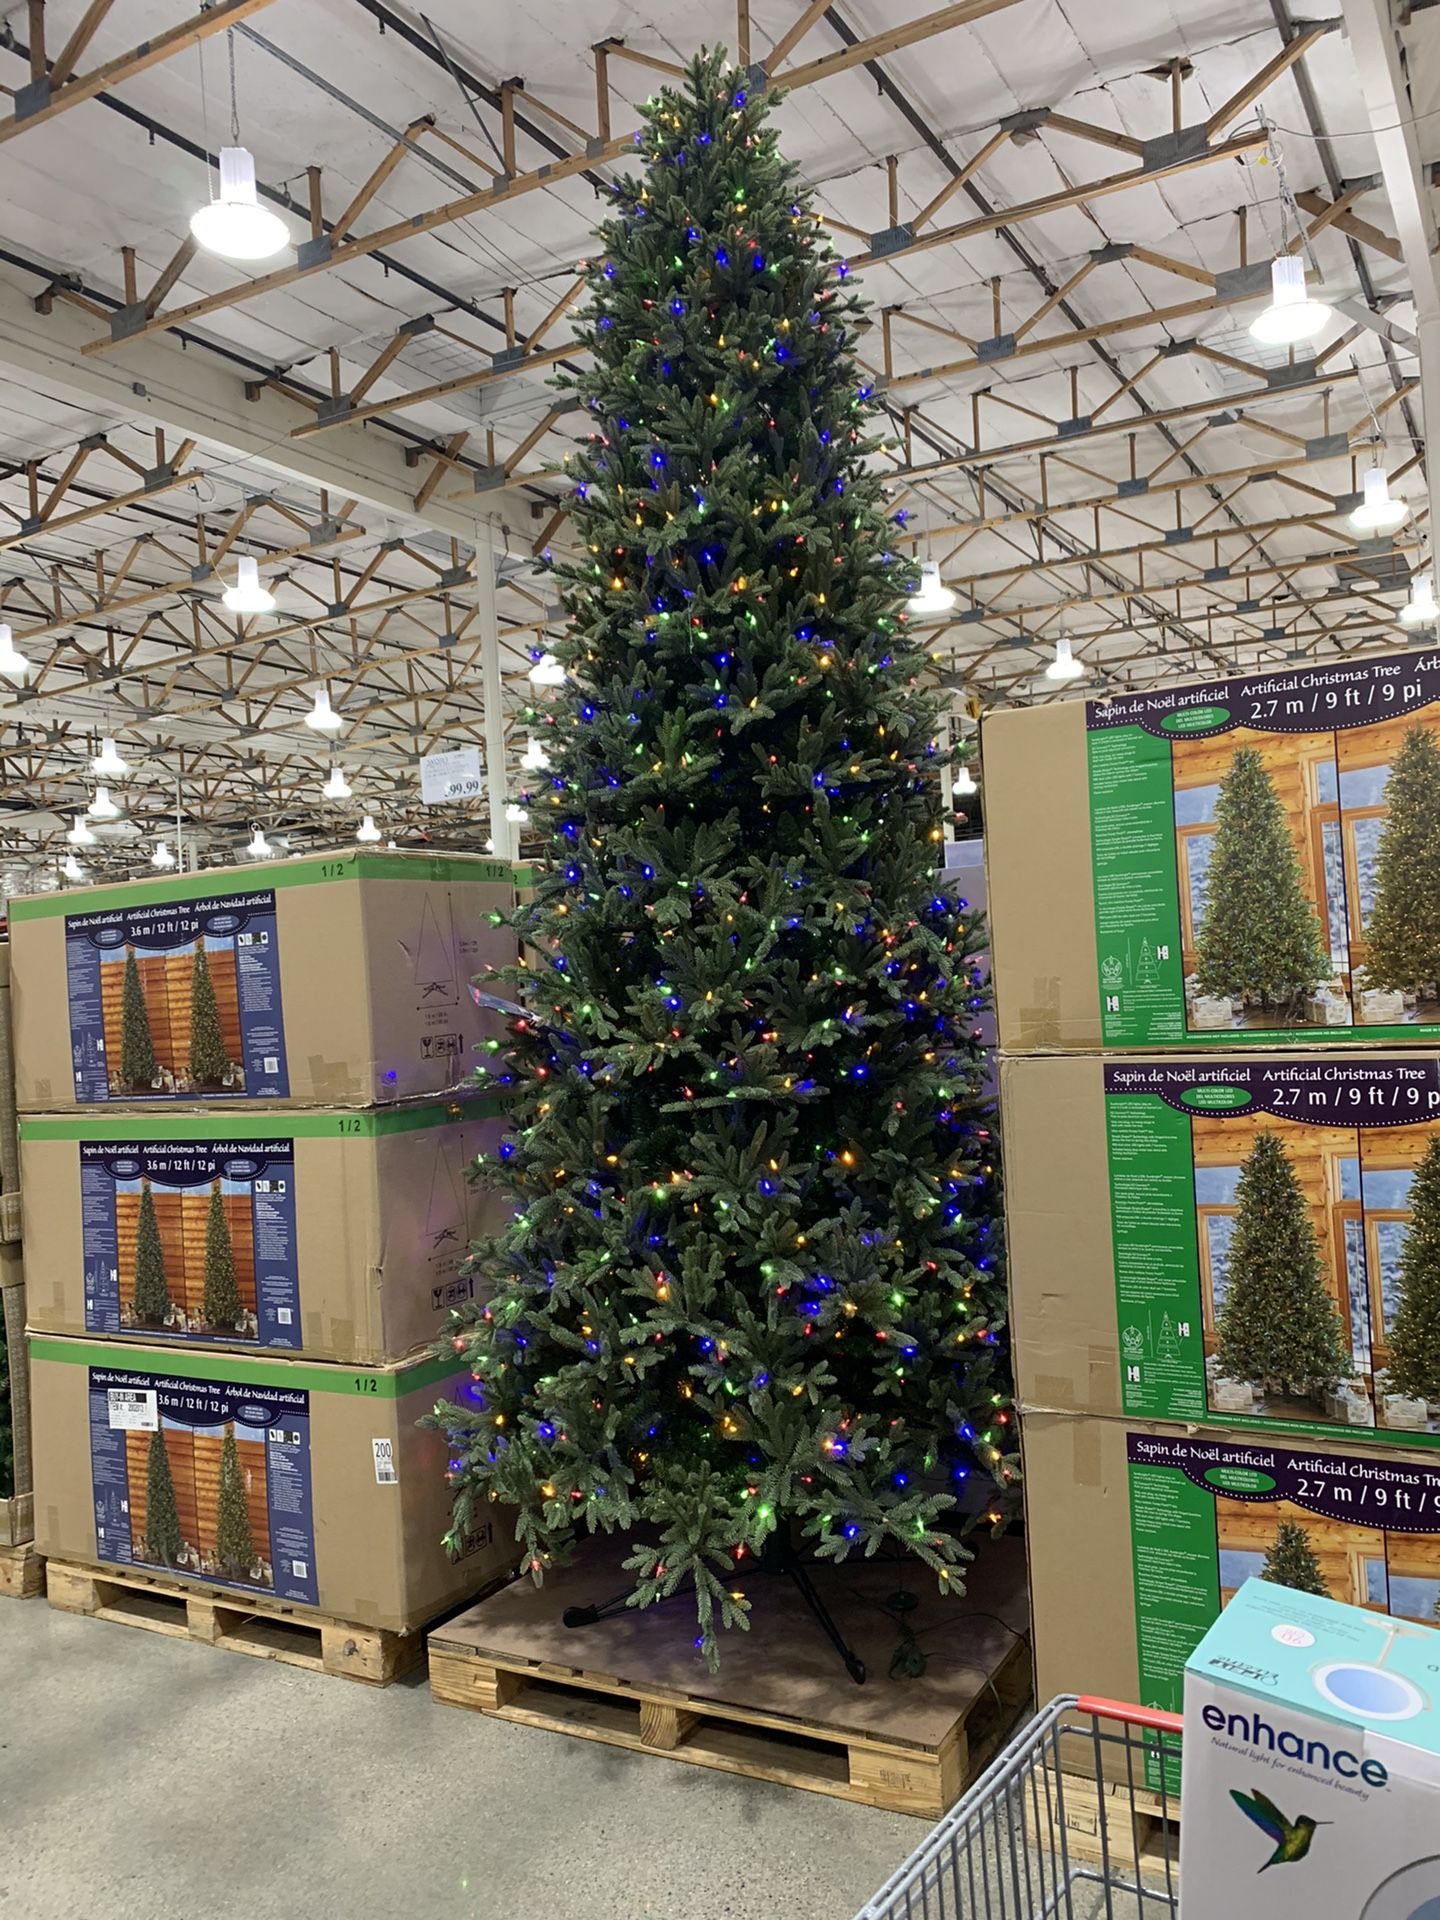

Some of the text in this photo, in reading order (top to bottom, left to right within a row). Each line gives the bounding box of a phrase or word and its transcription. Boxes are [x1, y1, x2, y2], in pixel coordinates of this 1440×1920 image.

[1094, 705, 1127, 720] Sapin
[1129, 701, 1144, 713] de
[1146, 694, 1176, 711] Noël
[1177, 686, 1229, 706] artificiel
[1240, 676, 1298, 697] Artificial
[1300, 669, 1369, 688] Christmas
[1371, 665, 1401, 678] Tree
[1250, 679, 1422, 719] 2.7 m / 9 ft / 9 pi
[444, 780, 479, 797] 99.99
[130, 926, 140, 937] 3.6
[143, 926, 150, 935] m
[157, 924, 165, 934] 12
[167, 921, 174, 932] ft
[180, 920, 189, 931] 12
[191, 918, 199, 932] pi
[1113, 1067, 1426, 1086] Sapin de Noël artificiel Artificial Christmas Tree
[1272, 1088, 1300, 1106] 2.7
[1309, 1091, 1327, 1105] m
[1334, 1087, 1342, 1106] /
[1349, 1087, 1361, 1105] 9
[1368, 1086, 1384, 1105] ft
[1391, 1087, 1399, 1106] /
[1407, 1087, 1419, 1105] 9
[147, 1160, 157, 1171] 3.6
[159, 1162, 166, 1170] m
[173, 1160, 182, 1170] 12
[183, 1160, 190, 1170] ft
[197, 1160, 206, 1171] 12
[208, 1159, 216, 1173] pi
[158, 1394, 170, 1405] 3.6
[170, 1397, 179, 1407] m
[186, 1398, 195, 1409] 12
[196, 1398, 203, 1410] ft
[210, 1401, 219, 1412] 12
[221, 1402, 229, 1415] pi
[375, 1443, 392, 1458] 200
[1136, 1440, 1169, 1458] Sapin
[1171, 1443, 1187, 1457] de
[1190, 1446, 1220, 1461] Noël
[1222, 1451, 1275, 1468] artificiel
[1286, 1458, 1347, 1476] Artificial
[1349, 1464, 1420, 1485] Christmas
[1297, 1478, 1325, 1498] 2.7
[1333, 1486, 1352, 1502] m
[1360, 1485, 1368, 1505] /
[1375, 1488, 1387, 1506] 9
[1395, 1489, 1411, 1510] ft
[1418, 1492, 1426, 1513] /
[1202, 1704, 1389, 1788] enhance
[1211, 1736, 1370, 1802] Natural light for enhanced beauty
